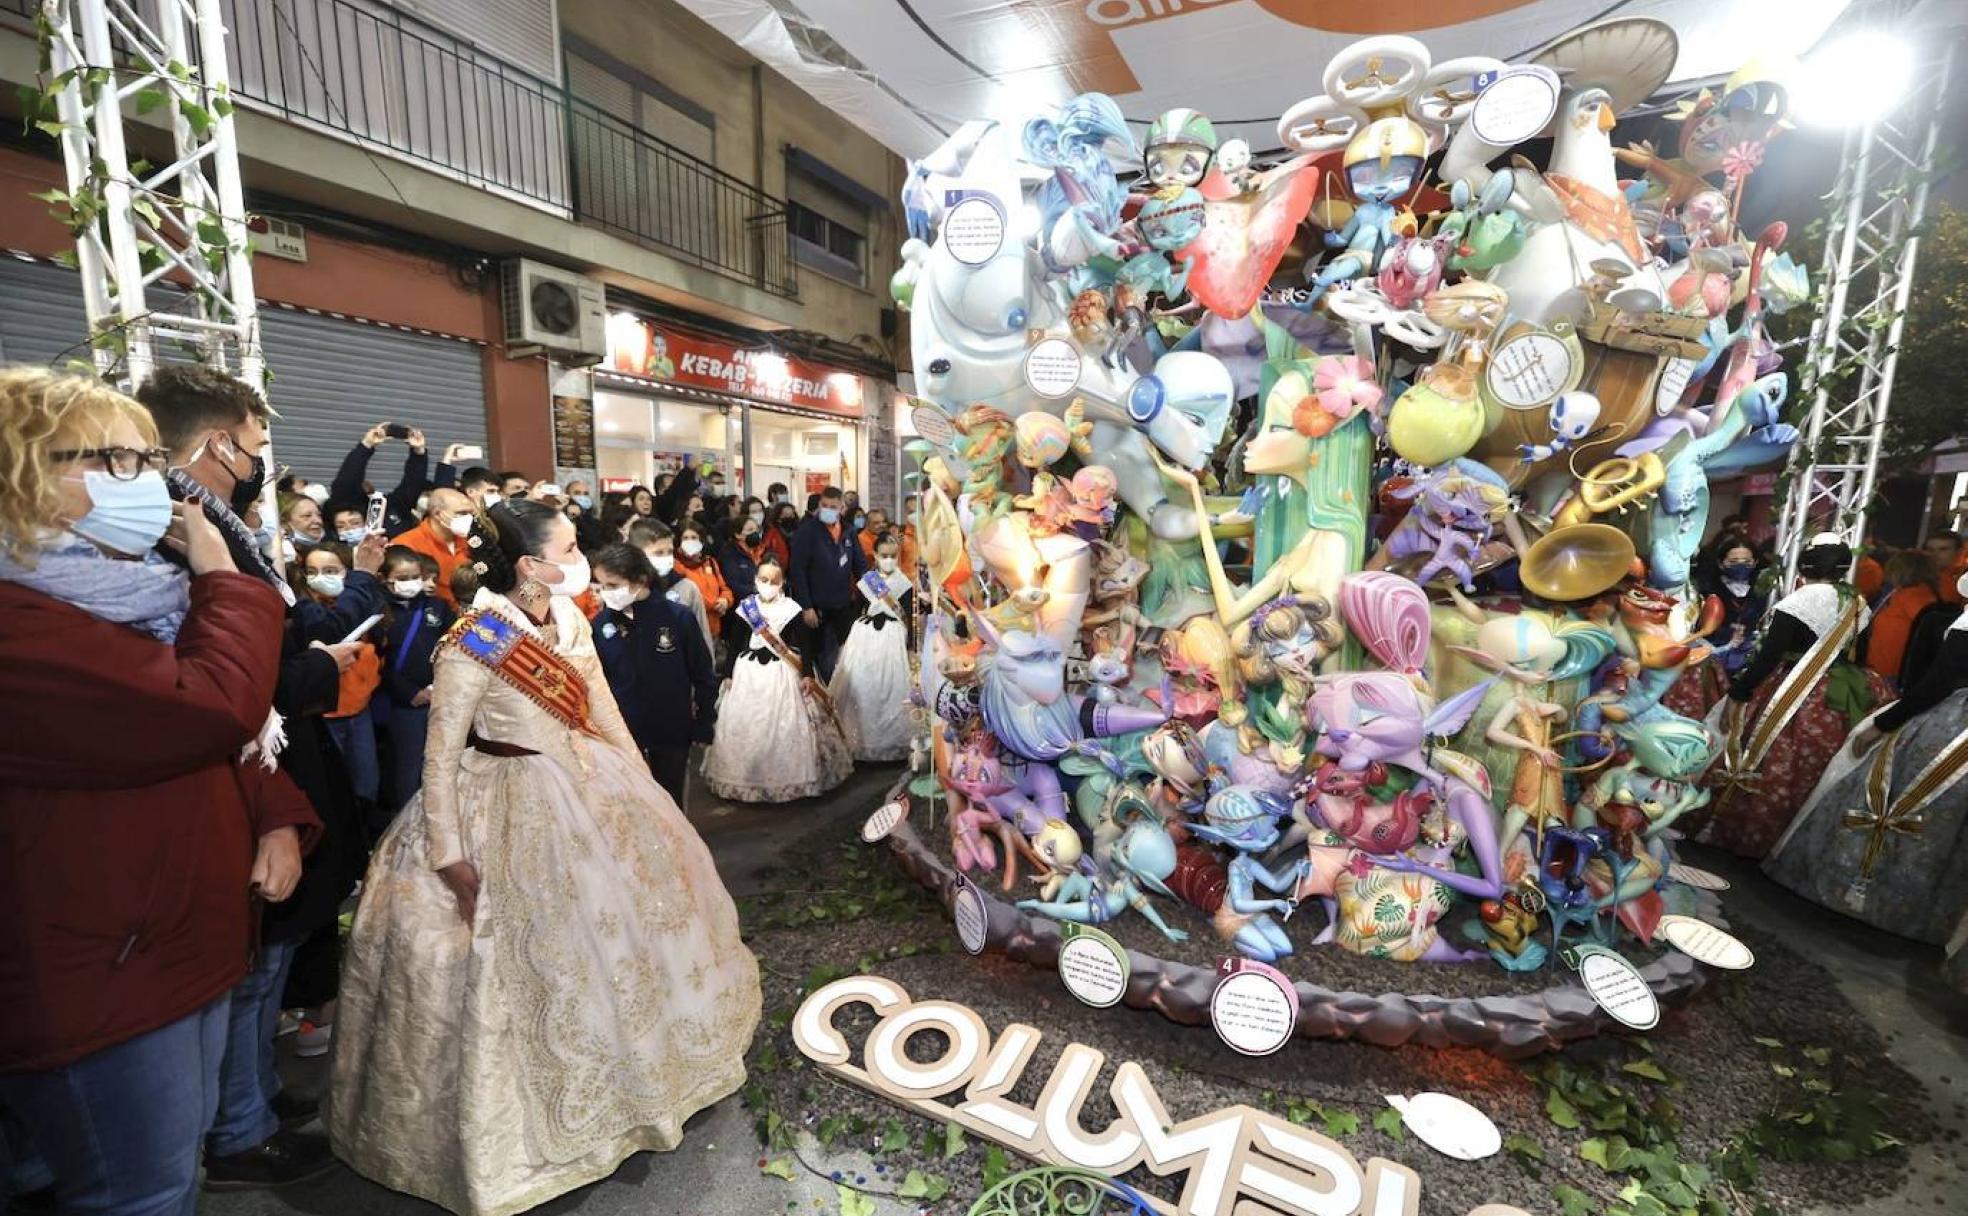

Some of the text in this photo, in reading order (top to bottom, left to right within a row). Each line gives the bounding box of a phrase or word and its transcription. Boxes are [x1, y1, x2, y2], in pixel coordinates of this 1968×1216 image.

[1477, 73, 1489, 86] 8
[681, 352, 828, 399] KEBAB-ZERIA
[1222, 958, 1233, 973] 4
[793, 976, 1420, 1216] COLUMBI
